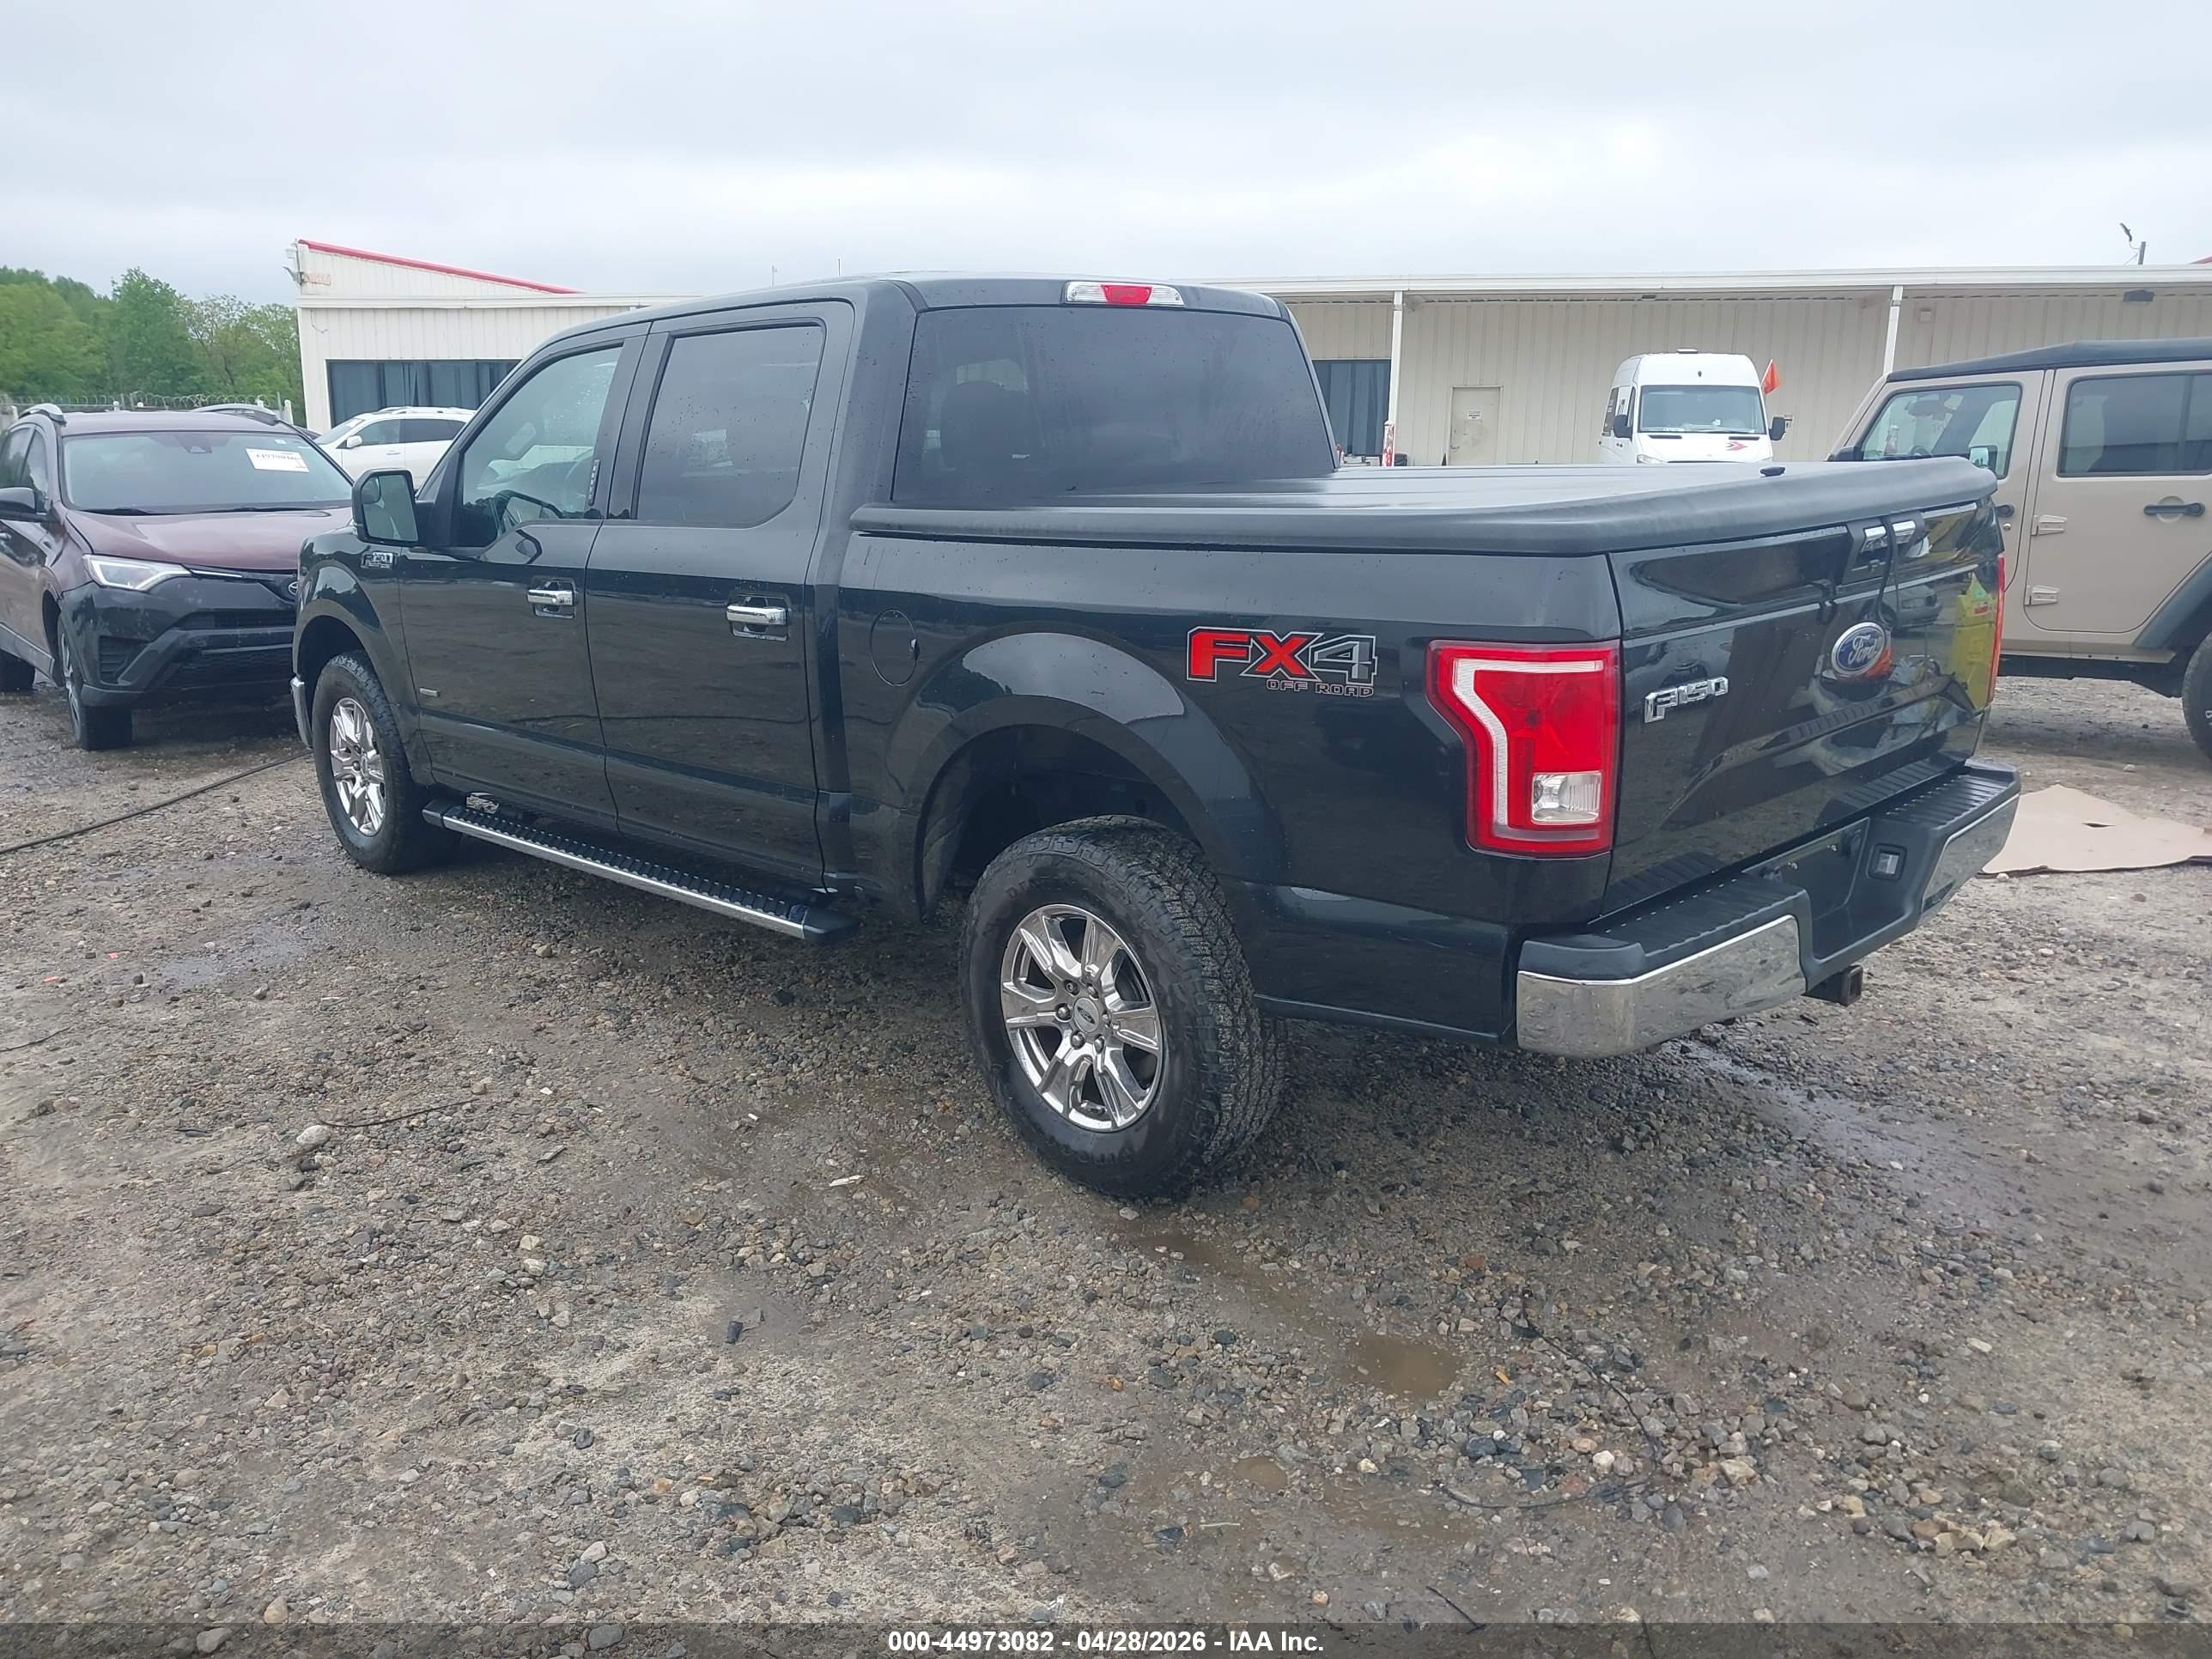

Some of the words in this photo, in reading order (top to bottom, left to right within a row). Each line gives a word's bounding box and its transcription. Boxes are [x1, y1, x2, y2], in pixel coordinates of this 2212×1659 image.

[1186, 625, 1378, 686] FX4
[1847, 634, 1878, 665] Ford
[1266, 678, 1308, 692] OFF
[1315, 683, 1374, 697] ROAD
[1644, 676, 1729, 723] F150
